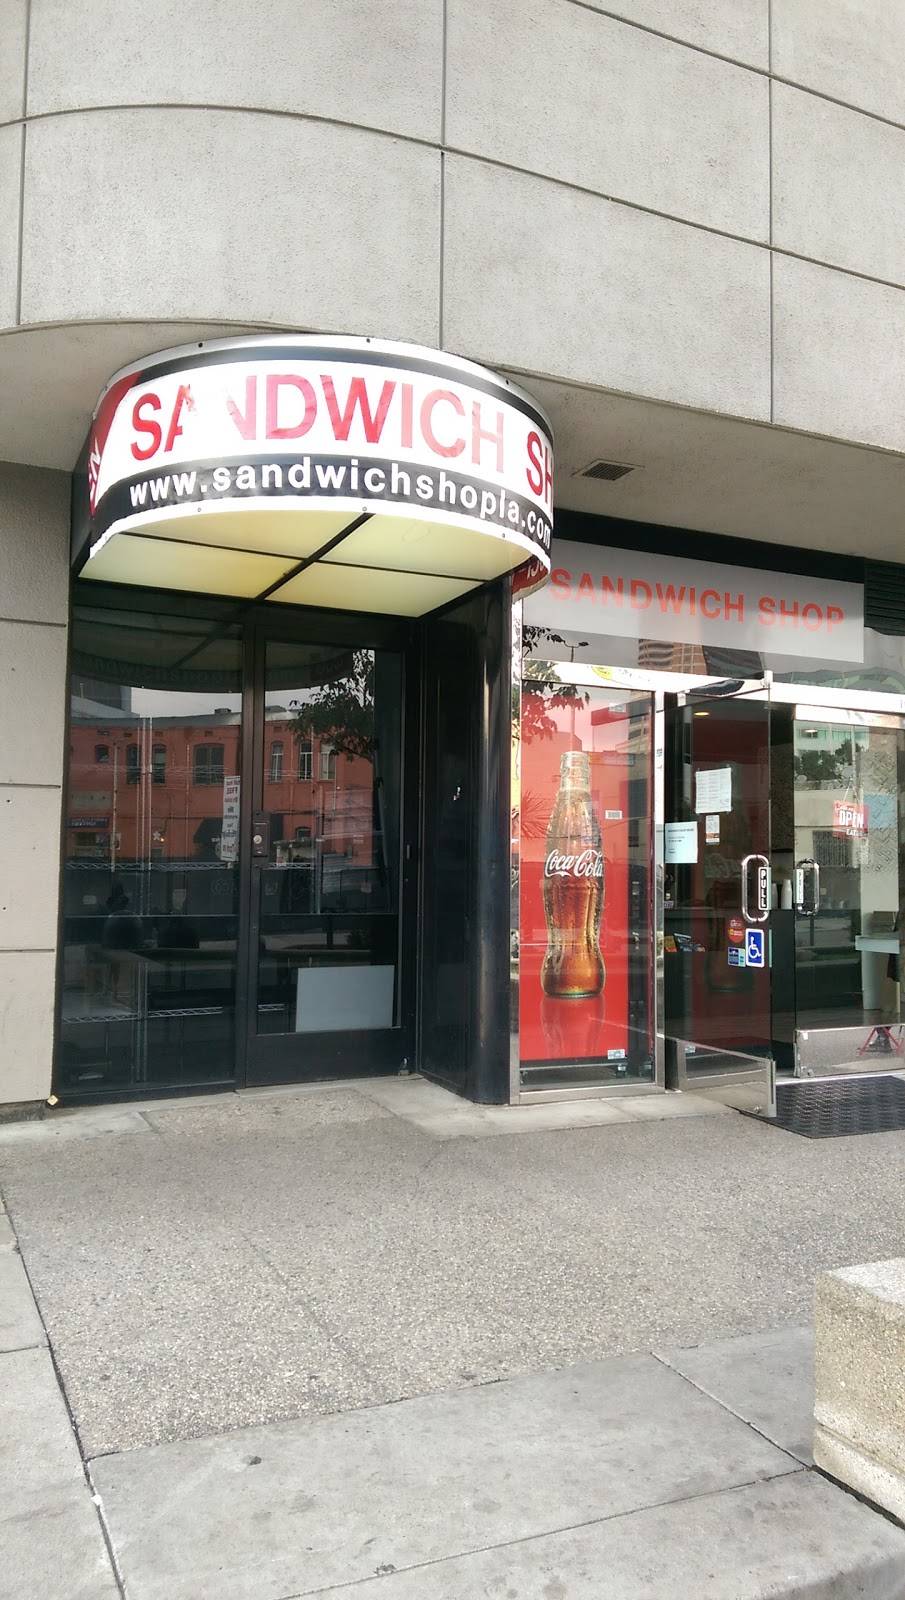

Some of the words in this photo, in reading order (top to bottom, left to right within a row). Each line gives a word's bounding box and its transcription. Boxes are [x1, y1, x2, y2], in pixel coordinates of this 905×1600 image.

[129, 457, 551, 549] www.sandwichshopla.com
[549, 568, 745, 624] SANDWICH
[758, 596, 845, 634] SHOP
[839, 810, 864, 829] OPEN
[544, 849, 603, 877] Coca-Cola
